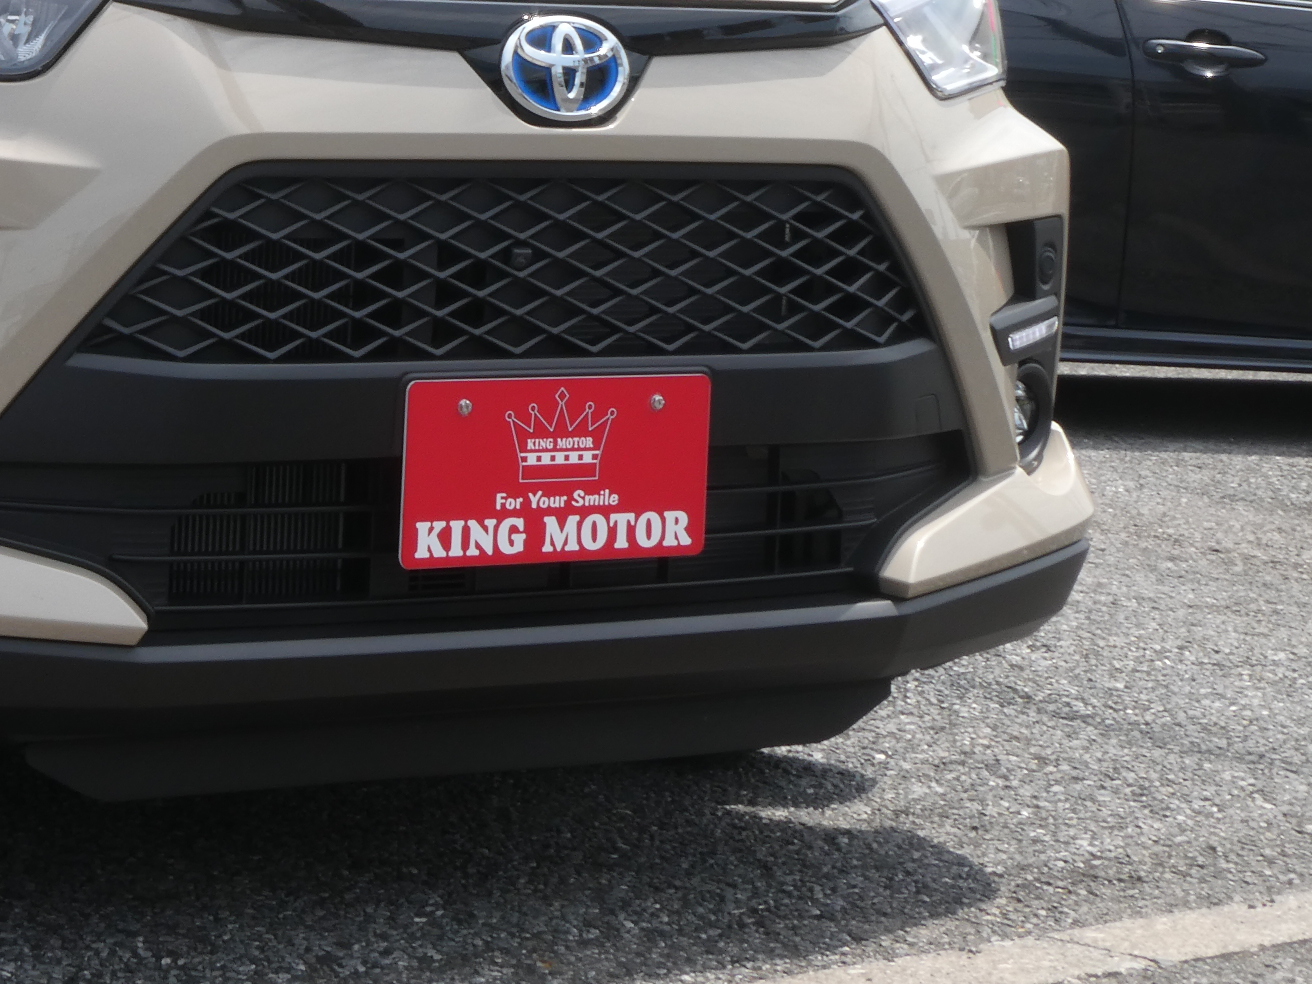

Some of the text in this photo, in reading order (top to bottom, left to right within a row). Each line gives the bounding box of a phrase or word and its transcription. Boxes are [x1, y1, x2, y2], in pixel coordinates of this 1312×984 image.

[527, 437, 594, 450] KING MOTOR
[495, 489, 620, 511] For Your Smile
[414, 510, 692, 559] KING MOTOR
